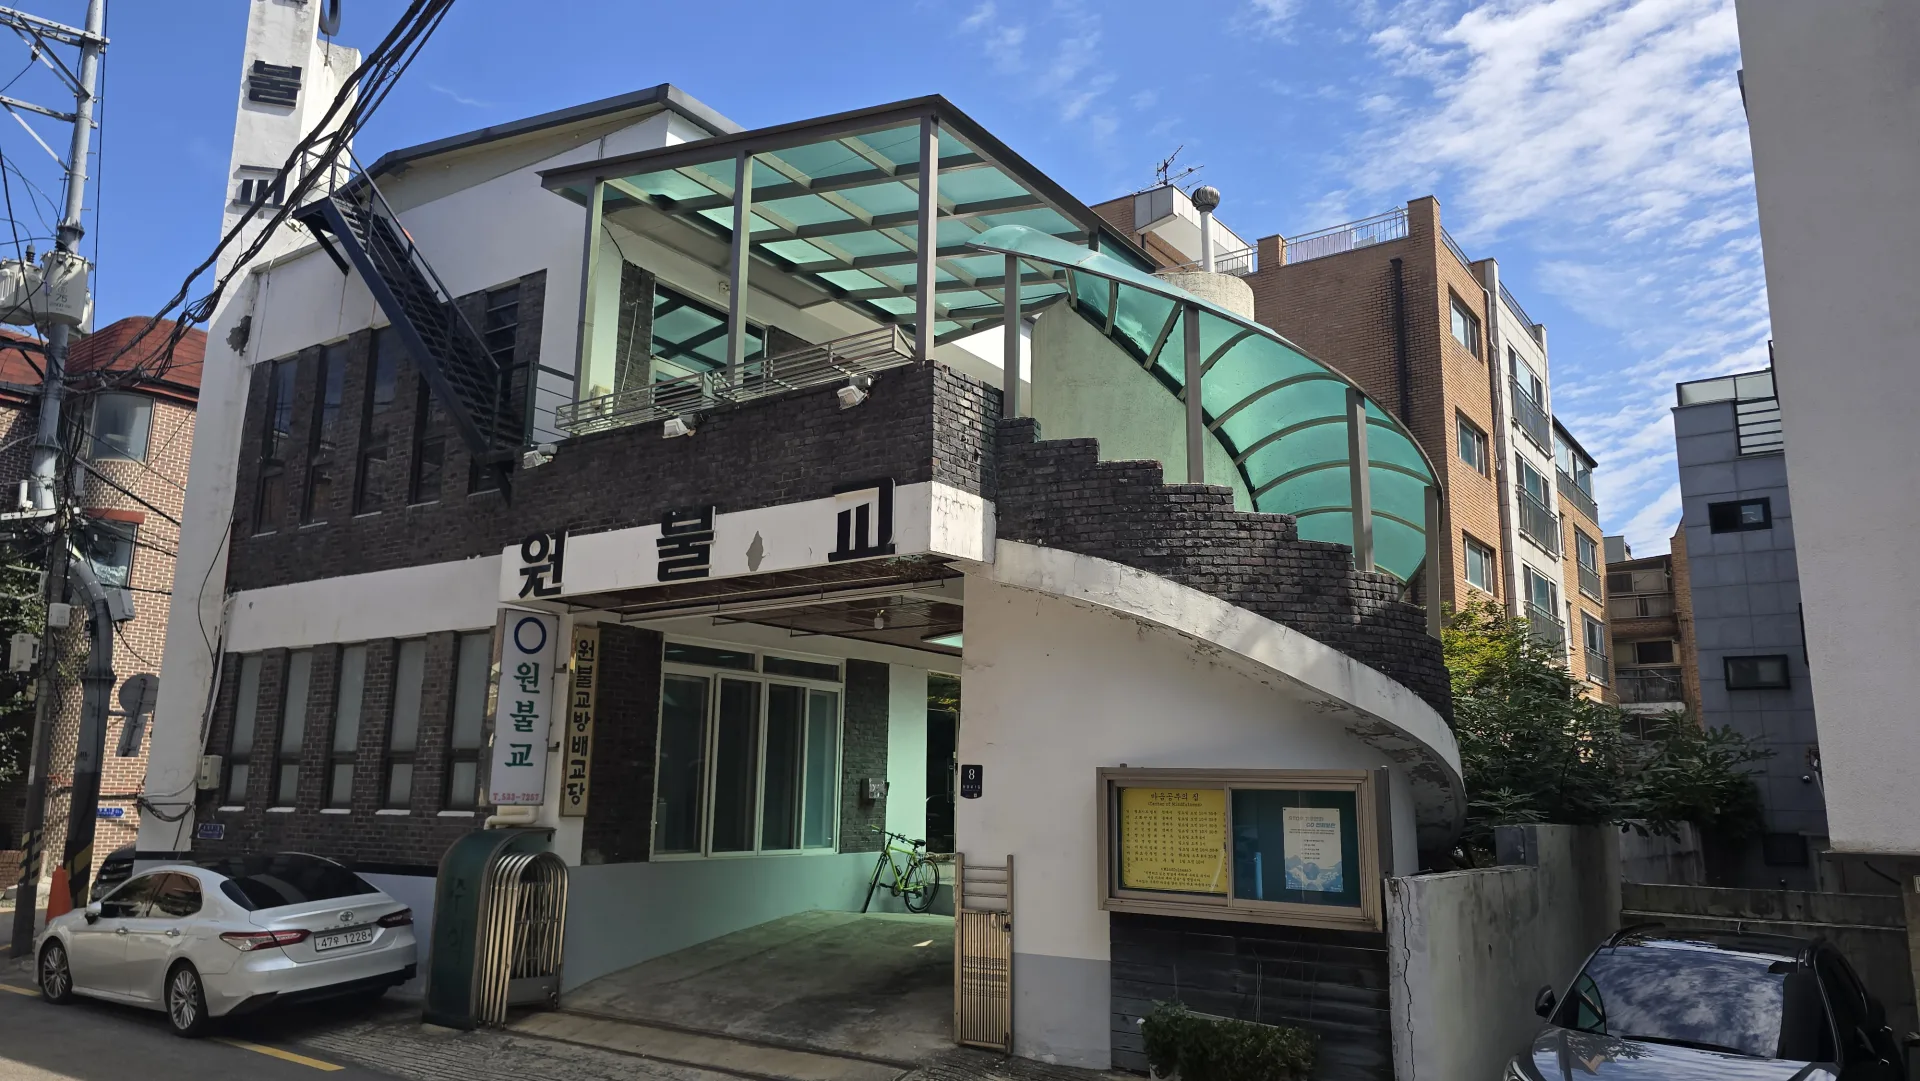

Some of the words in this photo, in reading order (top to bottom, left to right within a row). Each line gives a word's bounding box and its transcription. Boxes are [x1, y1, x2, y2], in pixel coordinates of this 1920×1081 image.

[505, 662, 540, 767] 원불교
[968, 768, 975, 780] 8
[344, 931, 367, 944] 1228
